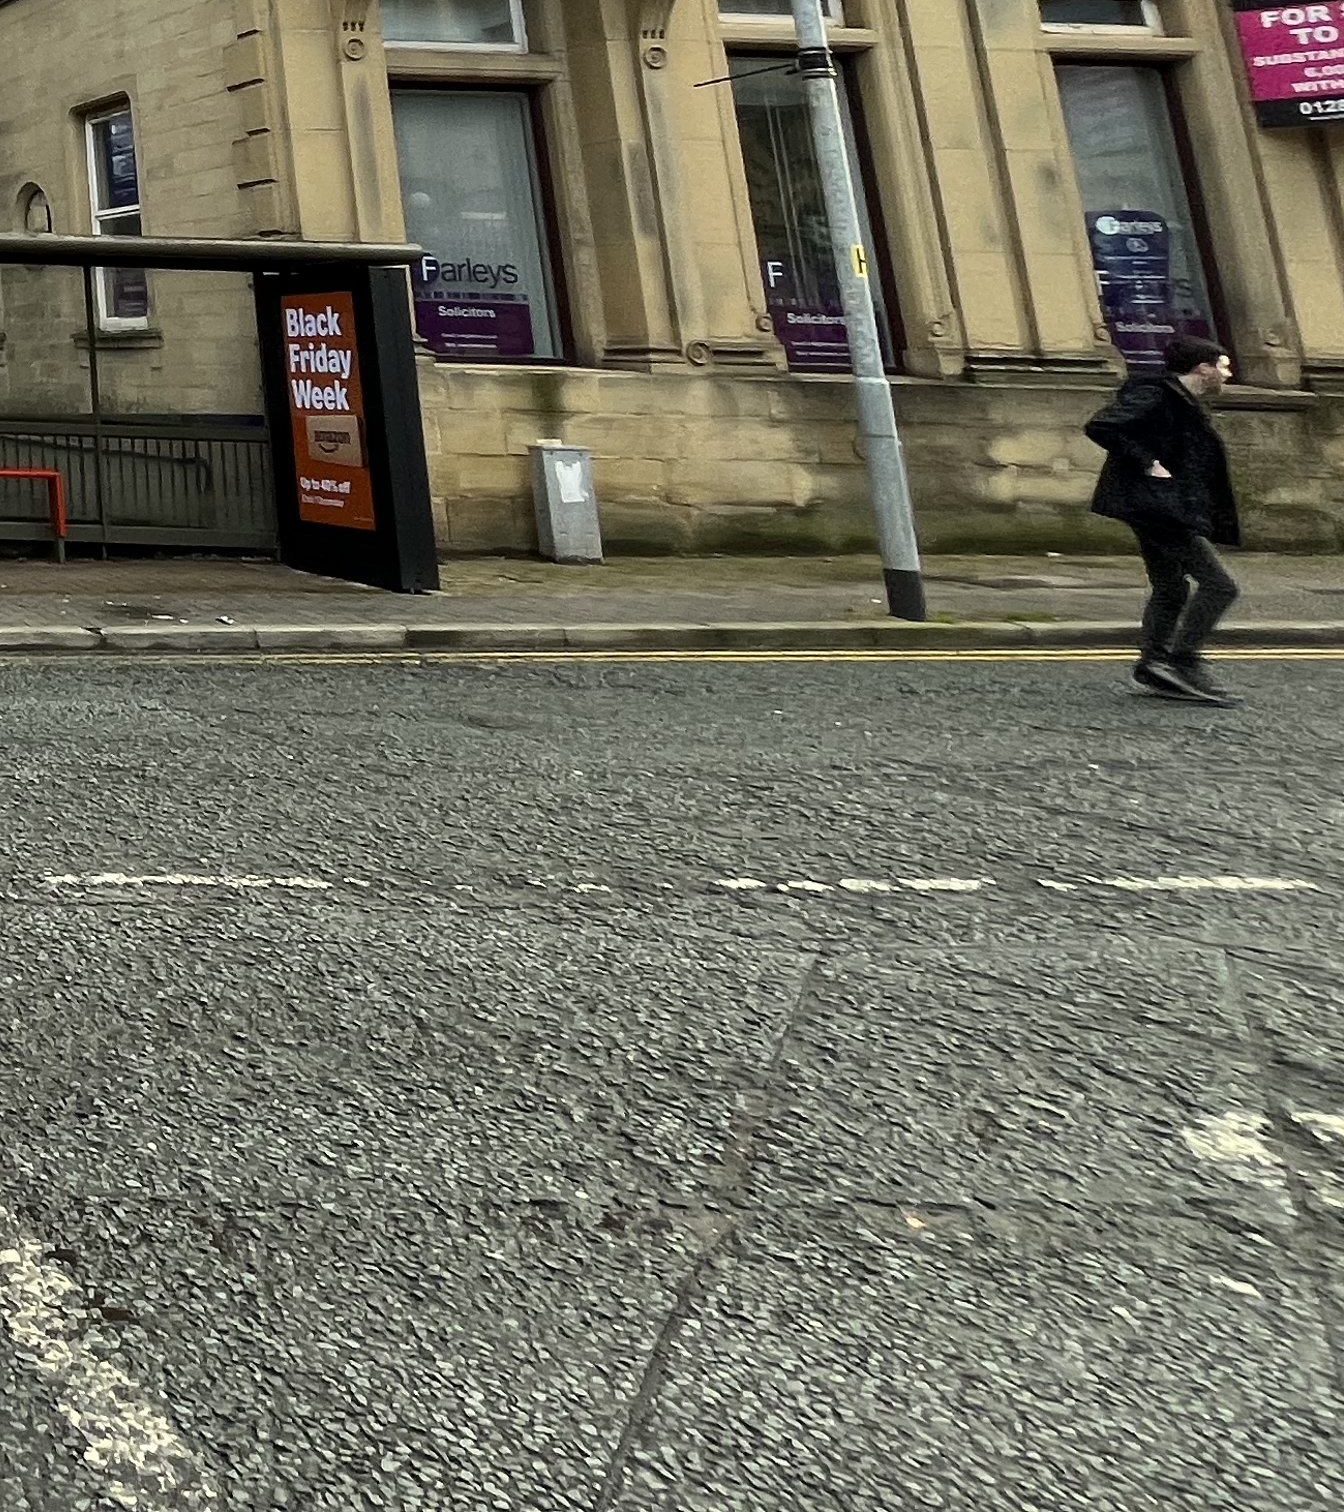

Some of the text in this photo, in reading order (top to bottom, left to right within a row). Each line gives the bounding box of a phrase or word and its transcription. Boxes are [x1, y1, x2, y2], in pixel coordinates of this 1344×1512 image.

[1260, 5, 1333, 29] FOR
[1289, 25, 1340, 45] TO
[421, 255, 519, 289] Farleys
[285, 305, 342, 337] Black
[438, 305, 497, 318] Solicitors
[288, 342, 352, 379] Friday
[291, 379, 350, 411] Week
